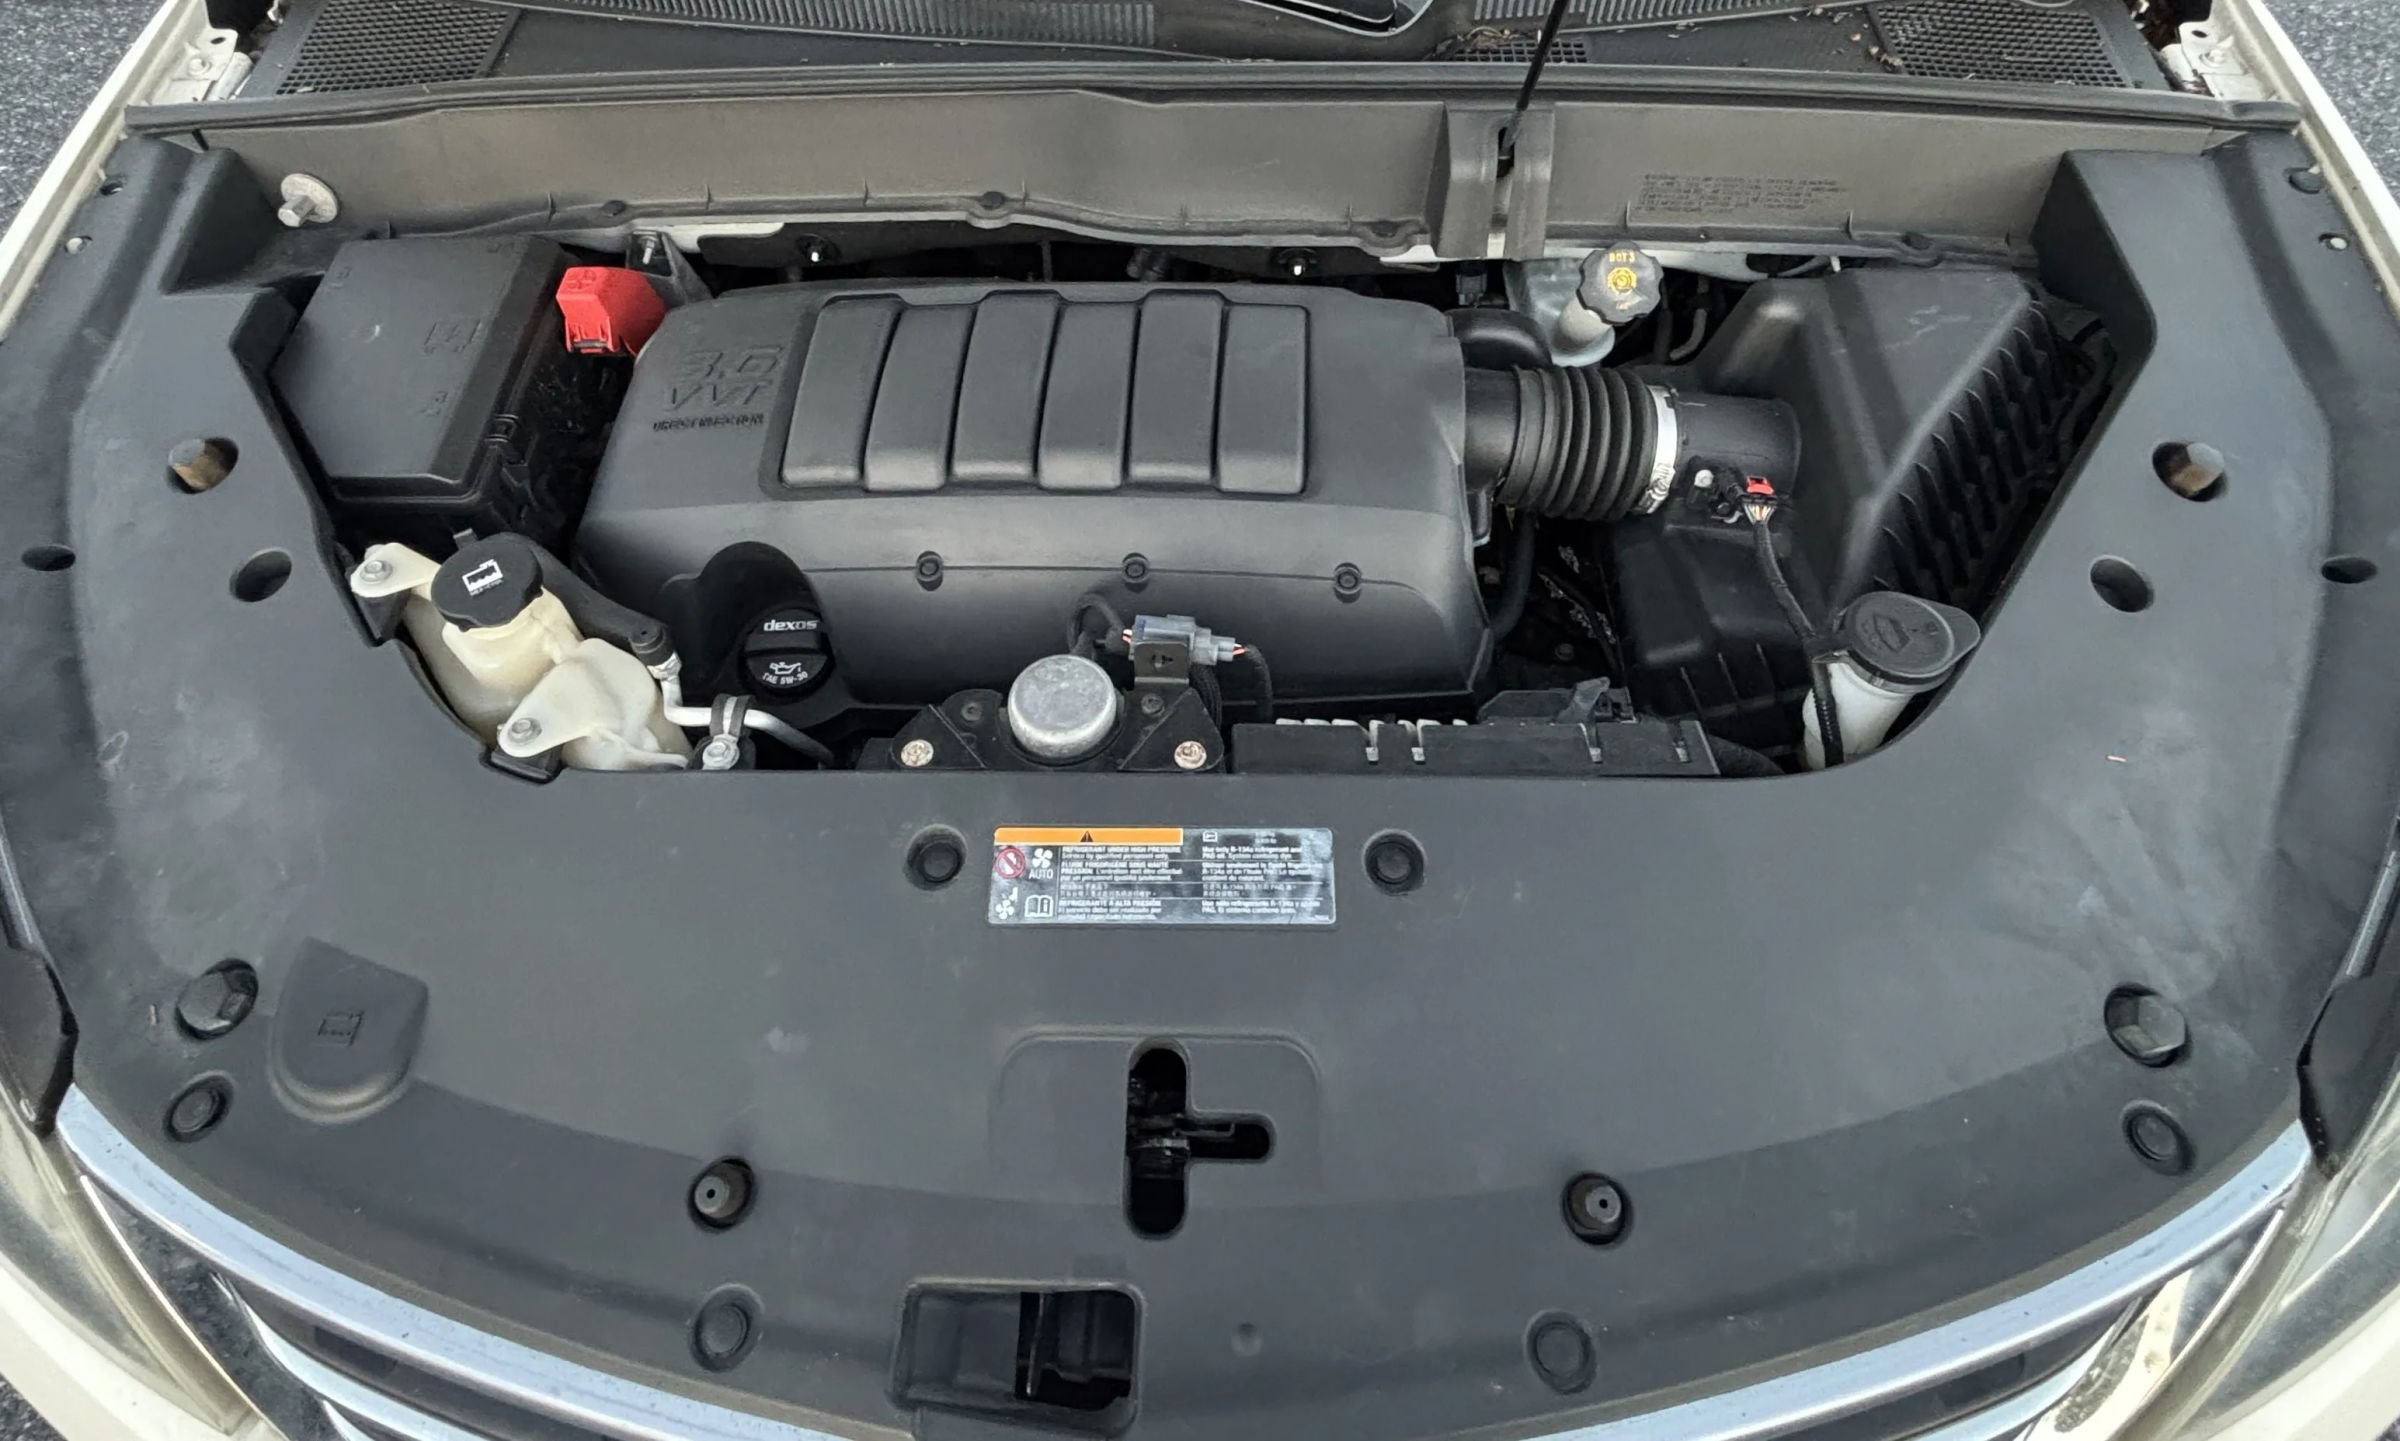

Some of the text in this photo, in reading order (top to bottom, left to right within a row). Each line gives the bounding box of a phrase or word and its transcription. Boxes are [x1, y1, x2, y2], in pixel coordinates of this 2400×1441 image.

[664, 378, 774, 411] VVT
[763, 619, 818, 632] dexos
[780, 671, 809, 685] 5W-30
[1028, 869, 1054, 880] AUTO
